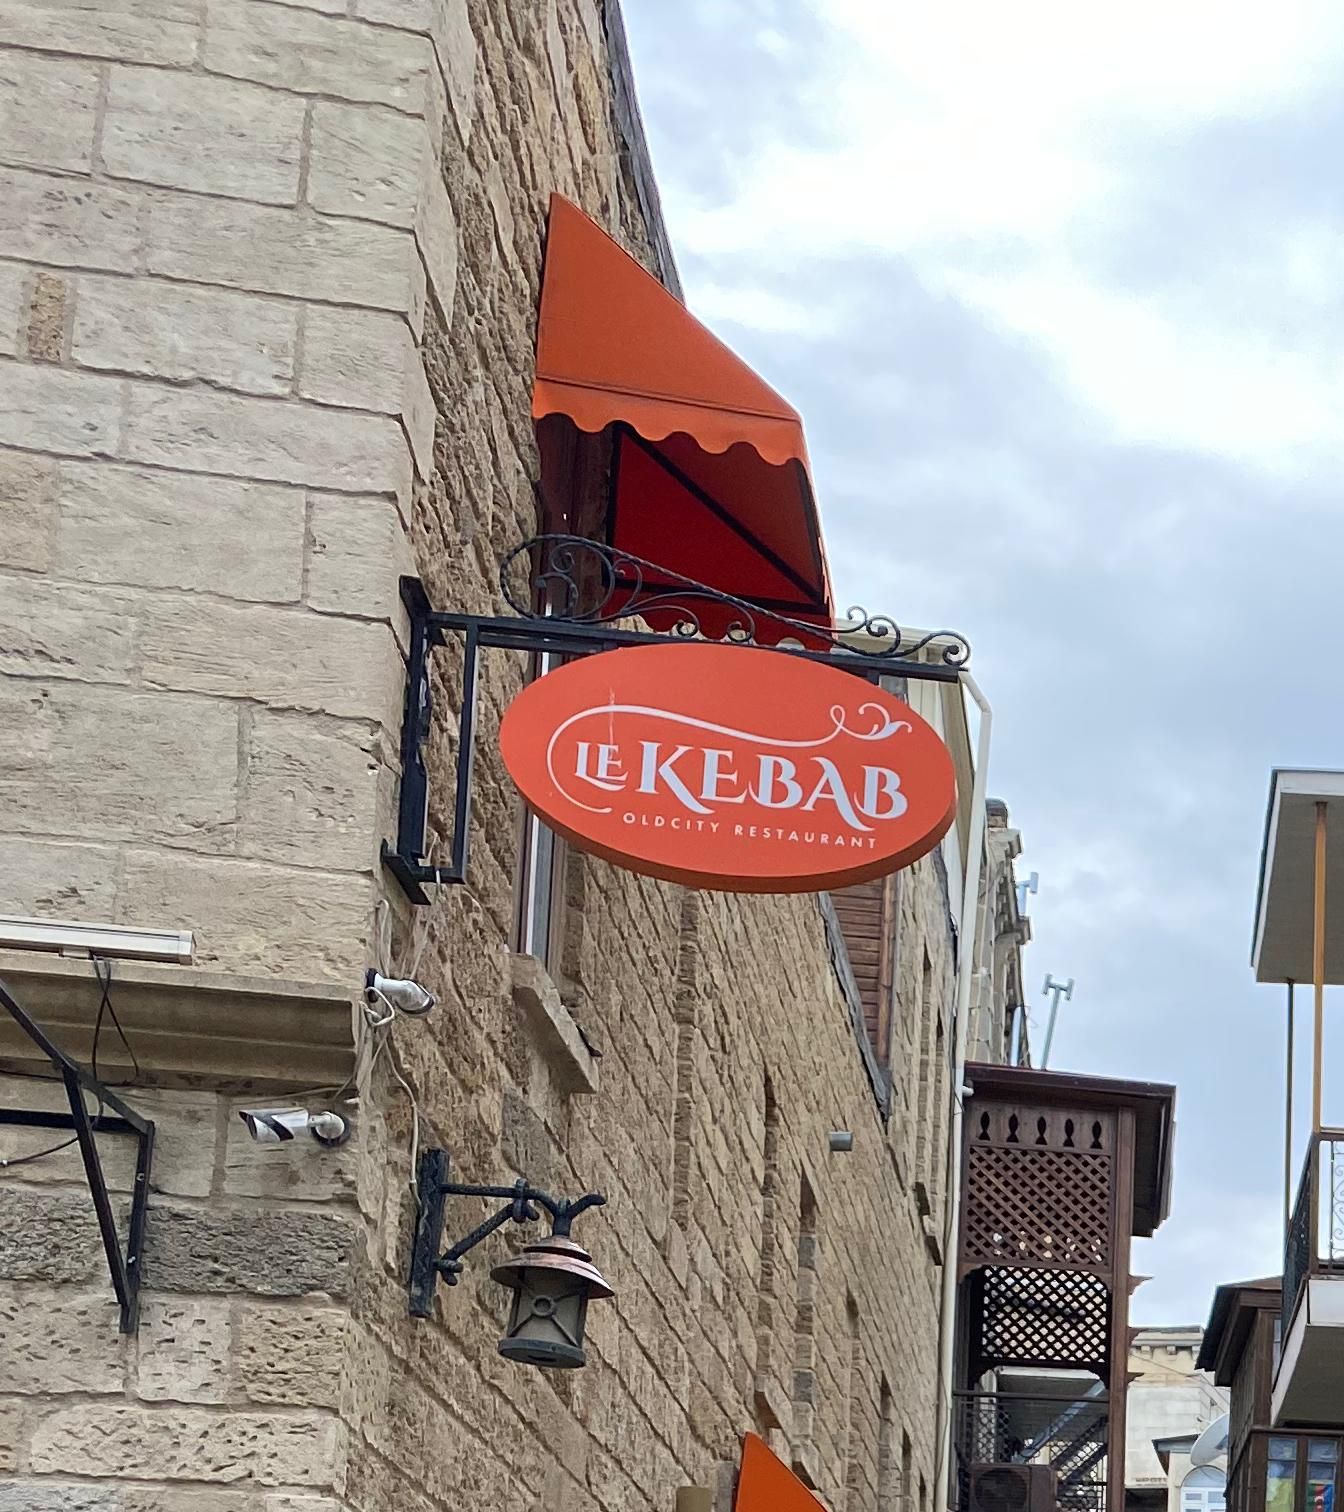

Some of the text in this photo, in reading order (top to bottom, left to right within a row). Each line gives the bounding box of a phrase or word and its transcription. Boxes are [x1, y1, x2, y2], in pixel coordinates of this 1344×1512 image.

[574, 740, 908, 831] LE KEBAB
[623, 812, 877, 849] OLDCITY RESTAURANT
